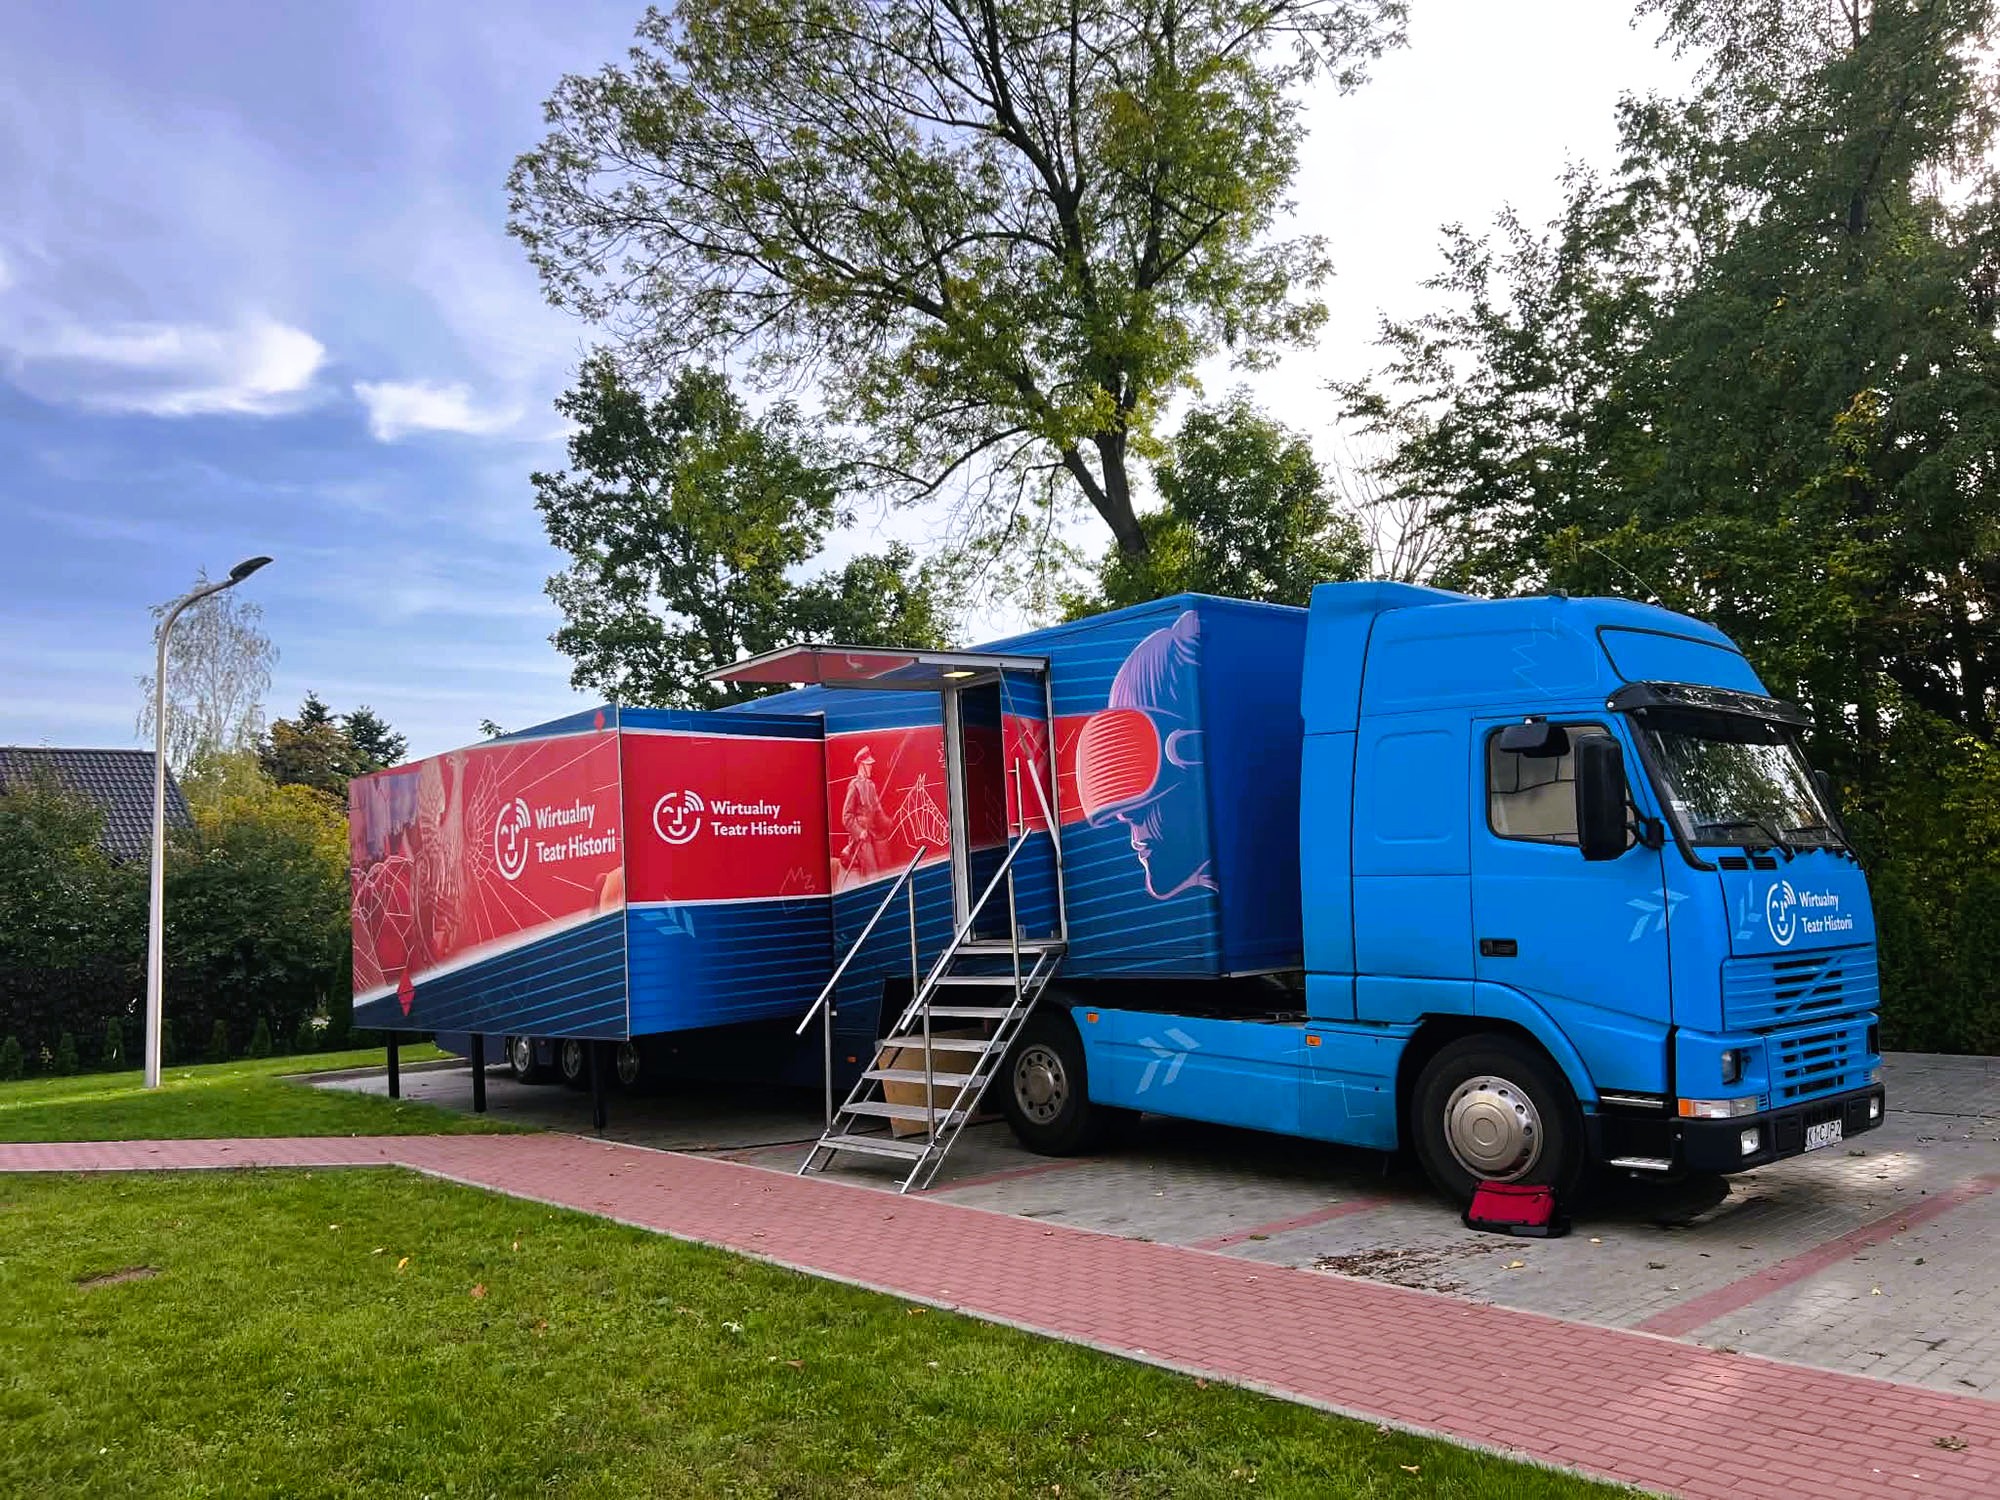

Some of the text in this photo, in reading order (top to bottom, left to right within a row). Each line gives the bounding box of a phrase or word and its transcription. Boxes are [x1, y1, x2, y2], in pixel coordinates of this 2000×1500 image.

[535, 798, 595, 830] Wirtualny
[710, 799, 781, 819] Wirtualny
[710, 820, 801, 836] Teatr Historii
[536, 828, 616, 863] Teatr Historii
[1799, 889, 1839, 911] Wirtualny
[1801, 914, 1853, 934] Teatr Historii
